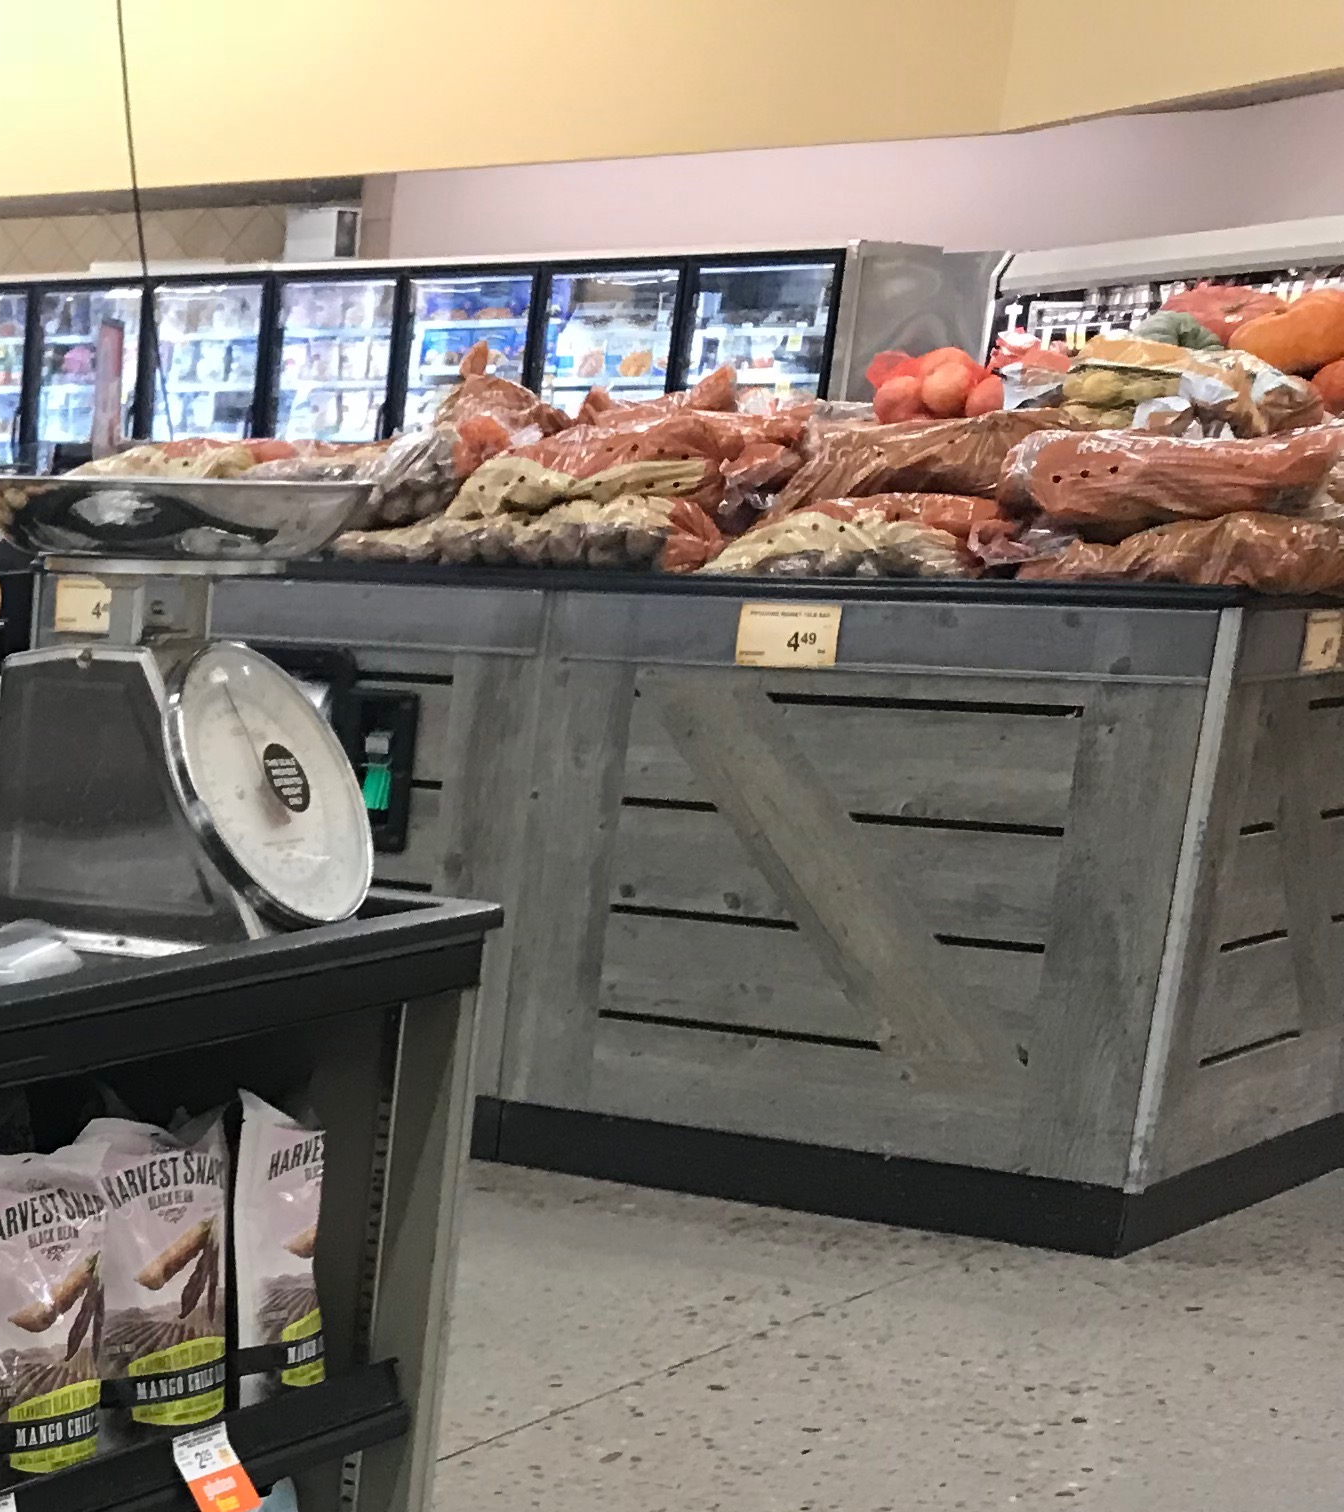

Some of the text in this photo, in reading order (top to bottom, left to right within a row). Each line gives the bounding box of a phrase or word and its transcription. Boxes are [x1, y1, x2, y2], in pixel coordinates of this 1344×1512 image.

[100, 1157, 181, 1211] HARVEST
[136, 1374, 185, 1401] MANGO
[15, 1422, 63, 1448] MANGO
